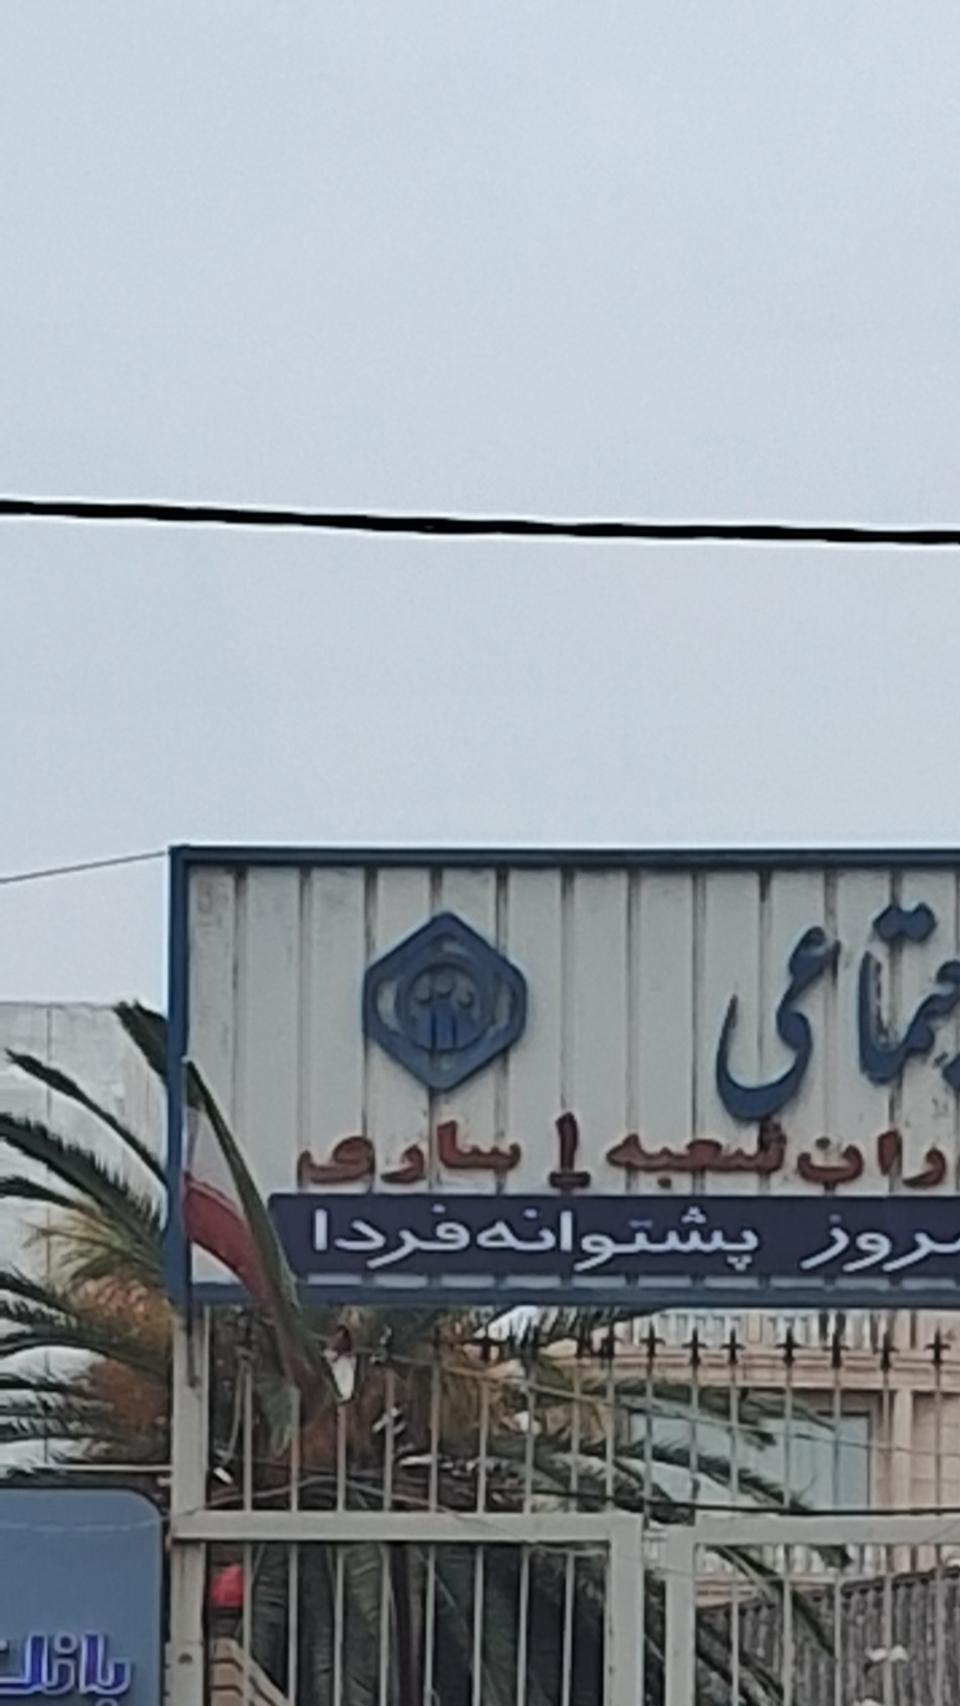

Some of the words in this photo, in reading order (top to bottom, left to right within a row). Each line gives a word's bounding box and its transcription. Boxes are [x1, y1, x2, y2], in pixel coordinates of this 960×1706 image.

[297, 1119, 521, 1185] ساری
[606, 1118, 788, 1188] شعبه
[313, 1203, 471, 1271] فردا
[475, 1205, 759, 1273] پشتوانه
